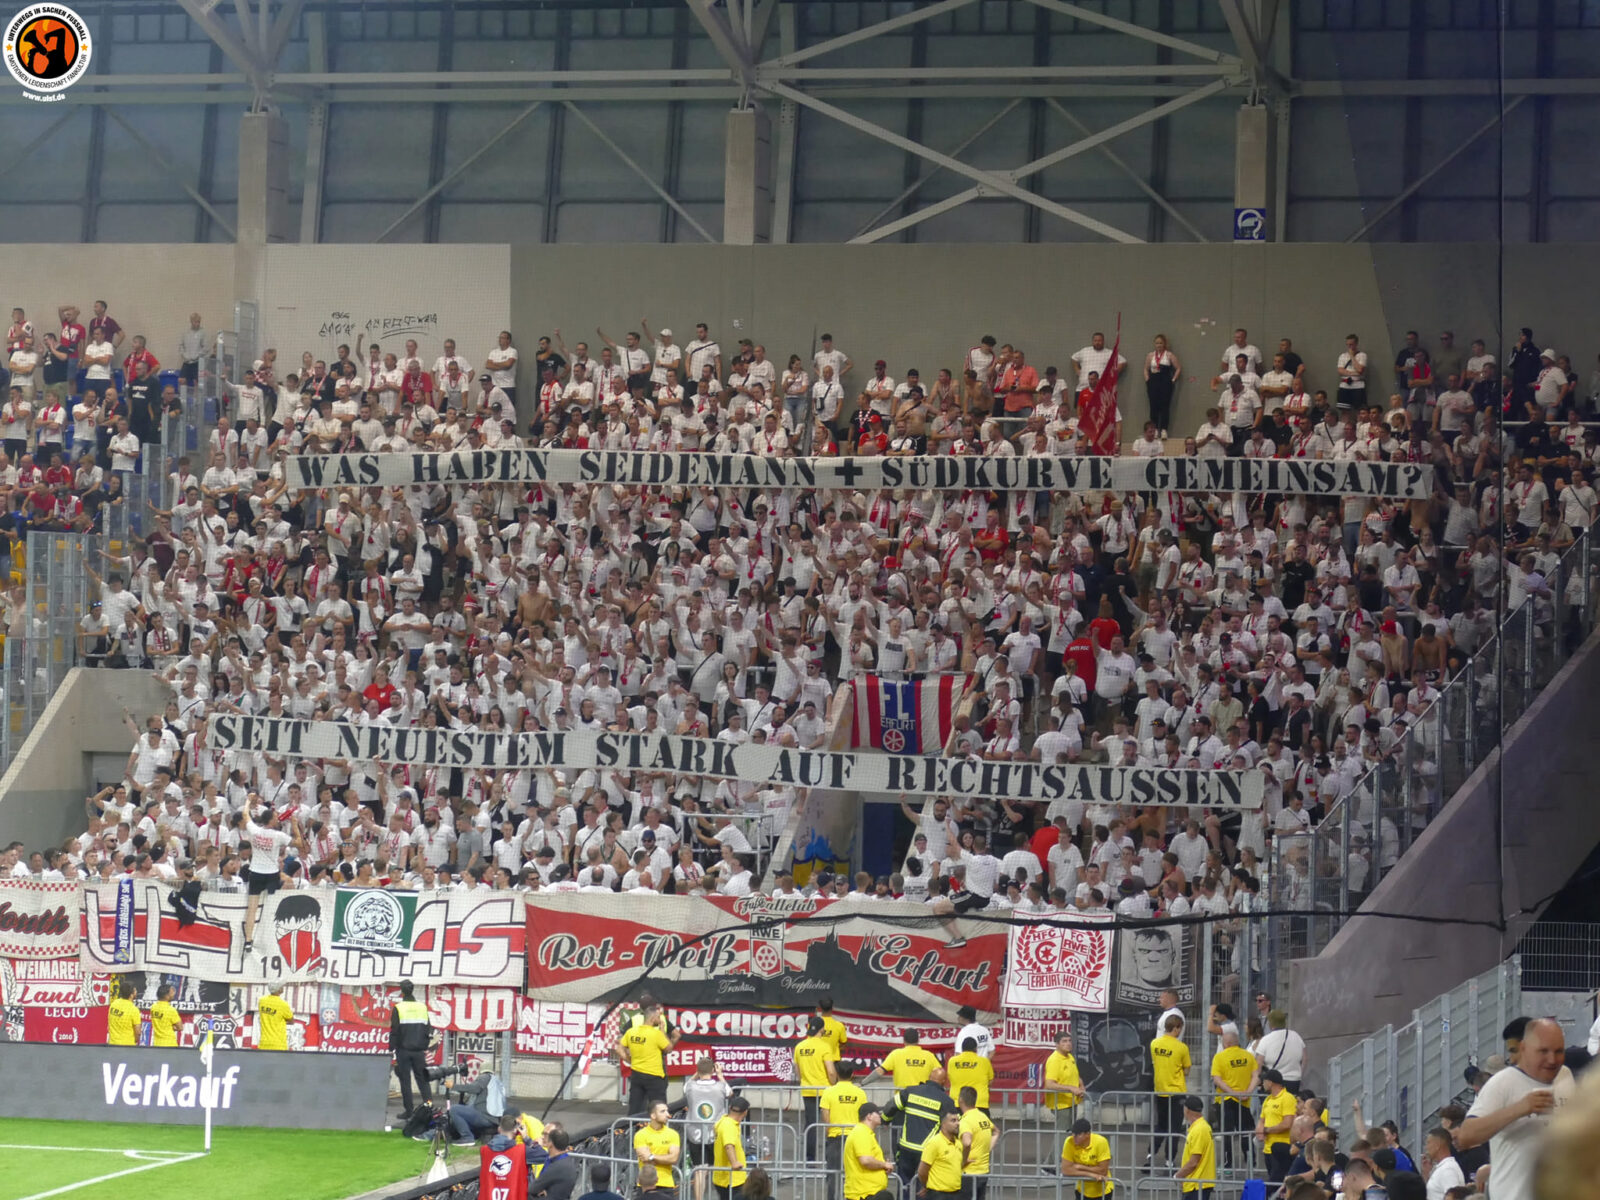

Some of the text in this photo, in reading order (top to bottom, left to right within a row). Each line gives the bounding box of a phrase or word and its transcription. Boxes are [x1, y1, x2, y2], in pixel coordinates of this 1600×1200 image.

[297, 450, 1422, 497] WAS HABEN SEIDEMANN + SÜDKURVE GEMEINSAM?
[880, 719, 917, 731] ERFURT
[214, 716, 1244, 805] SEIT NEUESTEM STARK AUF RECHTSAUSSEN
[1032, 928, 1084, 943] HFC FC
[1064, 941, 1087, 954] RWE
[869, 934, 991, 992] Erfurt
[1031, 975, 1088, 992] ERFURT HALLE
[17, 985, 82, 1004] Land
[45, 1006, 88, 1018] LEGIO
[516, 999, 606, 1036] WEST
[1017, 1008, 1063, 1019] GRUPPE
[201, 1021, 233, 1032] ROTS
[668, 1008, 809, 1039] LOS CHICOS
[1007, 1022, 1026, 1042] ILM
[458, 1037, 494, 1050] RWE
[102, 1062, 240, 1109] Verkauf
